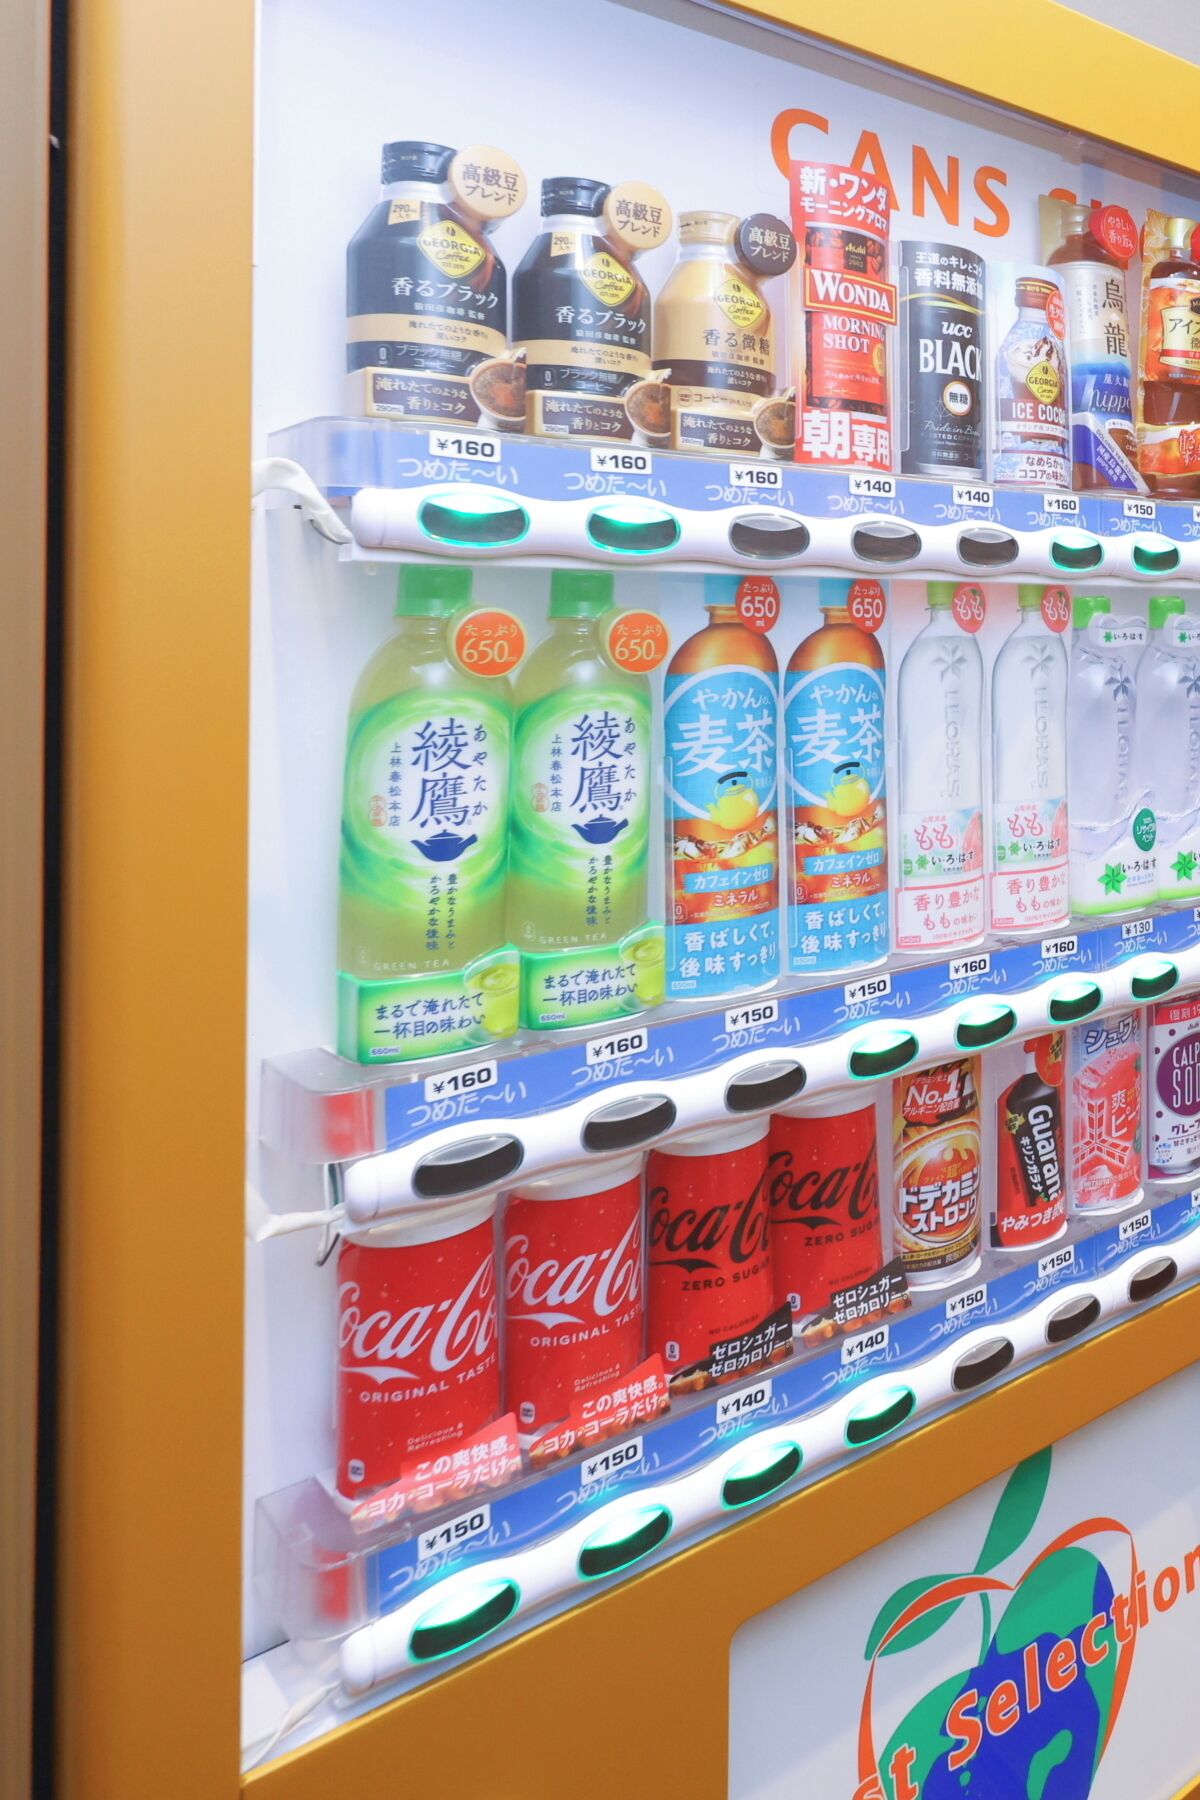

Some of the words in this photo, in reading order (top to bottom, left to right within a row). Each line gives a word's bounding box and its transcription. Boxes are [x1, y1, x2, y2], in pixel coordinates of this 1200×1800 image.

[462, 163, 519, 192] 高級豆
[770, 107, 1011, 238] CANS
[465, 184, 517, 206] ブレンド
[615, 199, 663, 226] 高級豆
[799, 196, 888, 233] モーニングアロマ
[617, 219, 661, 238] ブレンド
[750, 227, 791, 251] 高級豆
[750, 245, 790, 263] ブレンド
[583, 268, 631, 285] GEORGIA
[391, 276, 499, 309] 香るブラック
[810, 268, 892, 314] WONDA
[554, 305, 647, 334] 香るブラック
[1102, 279, 1128, 358] 烏龍
[703, 329, 770, 355] 香る微糖
[823, 333, 870, 354] SHOT
[375, 376, 469, 400] 淹れたてのような
[406, 396, 467, 415] 香りとコク
[1012, 402, 1034, 419] ICE
[571, 417, 622, 433] 香りとコク
[802, 409, 890, 466] 朝専用
[436, 438, 495, 458] ¥160
[707, 432, 752, 446] 香りとコク
[597, 453, 647, 471] ¥160
[734, 469, 779, 486] ¥160
[854, 480, 892, 494] ¥140
[956, 490, 990, 503] ¥140
[1047, 498, 1077, 511] ¥160
[1127, 503, 1153, 516] ¥150
[743, 583, 775, 593] たっぷり
[853, 585, 881, 596] たっぷり
[740, 597, 776, 618] 650
[852, 598, 883, 618] 650
[953, 595, 984, 620] もも
[1042, 597, 1069, 621] もも
[464, 623, 519, 638] たっぷり
[616, 623, 662, 637] たっぷり
[671, 709, 776, 777] 麦茶
[791, 703, 883, 767] 麦茶
[472, 725, 488, 817] あやたか
[569, 710, 625, 813] 綾鷹
[622, 716, 637, 802] あやたか
[387, 741, 402, 828] 上林春松本店
[408, 717, 472, 828] 綾鷹
[549, 732, 563, 813] 上林春松本店
[914, 824, 955, 851] もも
[1007, 812, 1044, 838] もも
[812, 851, 879, 872] カフェインゼロ
[694, 867, 769, 891] カフェインゼロ
[831, 871, 871, 889] ミネラル
[714, 889, 758, 908] ミネラル
[425, 874, 441, 951] かろやかな後味
[445, 873, 459, 950] 豊かなうまみと
[804, 902, 884, 930] 香ばしくて、
[539, 934, 579, 945] GREEN
[585, 932, 607, 942] TEA
[683, 922, 775, 953] 香ばしくて、
[800, 922, 886, 955] 後味すっきり
[1124, 920, 1151, 936] ¥130
[679, 942, 776, 978] 後味すっきり
[1044, 941, 1075, 955] ¥160
[373, 961, 417, 972] GREEN
[425, 958, 450, 969] TEA
[542, 963, 637, 990] まるで淹れたて
[953, 959, 987, 975] ¥160
[542, 982, 639, 1007] 一杯目の味わい
[848, 978, 887, 999] ¥150
[374, 992, 484, 1021] まるで淹れたて
[730, 1005, 774, 1026] ¥150
[373, 1013, 486, 1040] 一杯目の味わい
[592, 1034, 643, 1057] ¥160
[432, 1067, 492, 1094] ¥160
[1020, 1136, 1044, 1193] キリンガラナ
[1121, 1215, 1149, 1235] ¥150
[804, 1232, 845, 1247] ZERO
[1041, 1251, 1072, 1272] ¥150
[681, 1277, 725, 1292] ZERO
[833, 1274, 902, 1309] ゼロシュガー
[833, 1290, 910, 1325] ゼロカロリー。
[949, 1290, 984, 1311] ¥150
[530, 1326, 610, 1348] ORIGINAL
[712, 1323, 789, 1361] ゼロシュガー
[846, 1331, 885, 1358] ¥140
[708, 1339, 792, 1379] ゼロカロリー。
[359, 1381, 449, 1403] ORIGINAL
[456, 1354, 496, 1384] TASTE
[581, 1374, 664, 1419] この爽快感。
[720, 1388, 765, 1415] ¥140
[415, 1435, 516, 1482] この爽快感。
[587, 1444, 638, 1478] ¥150
[424, 1513, 485, 1551] ¥150
